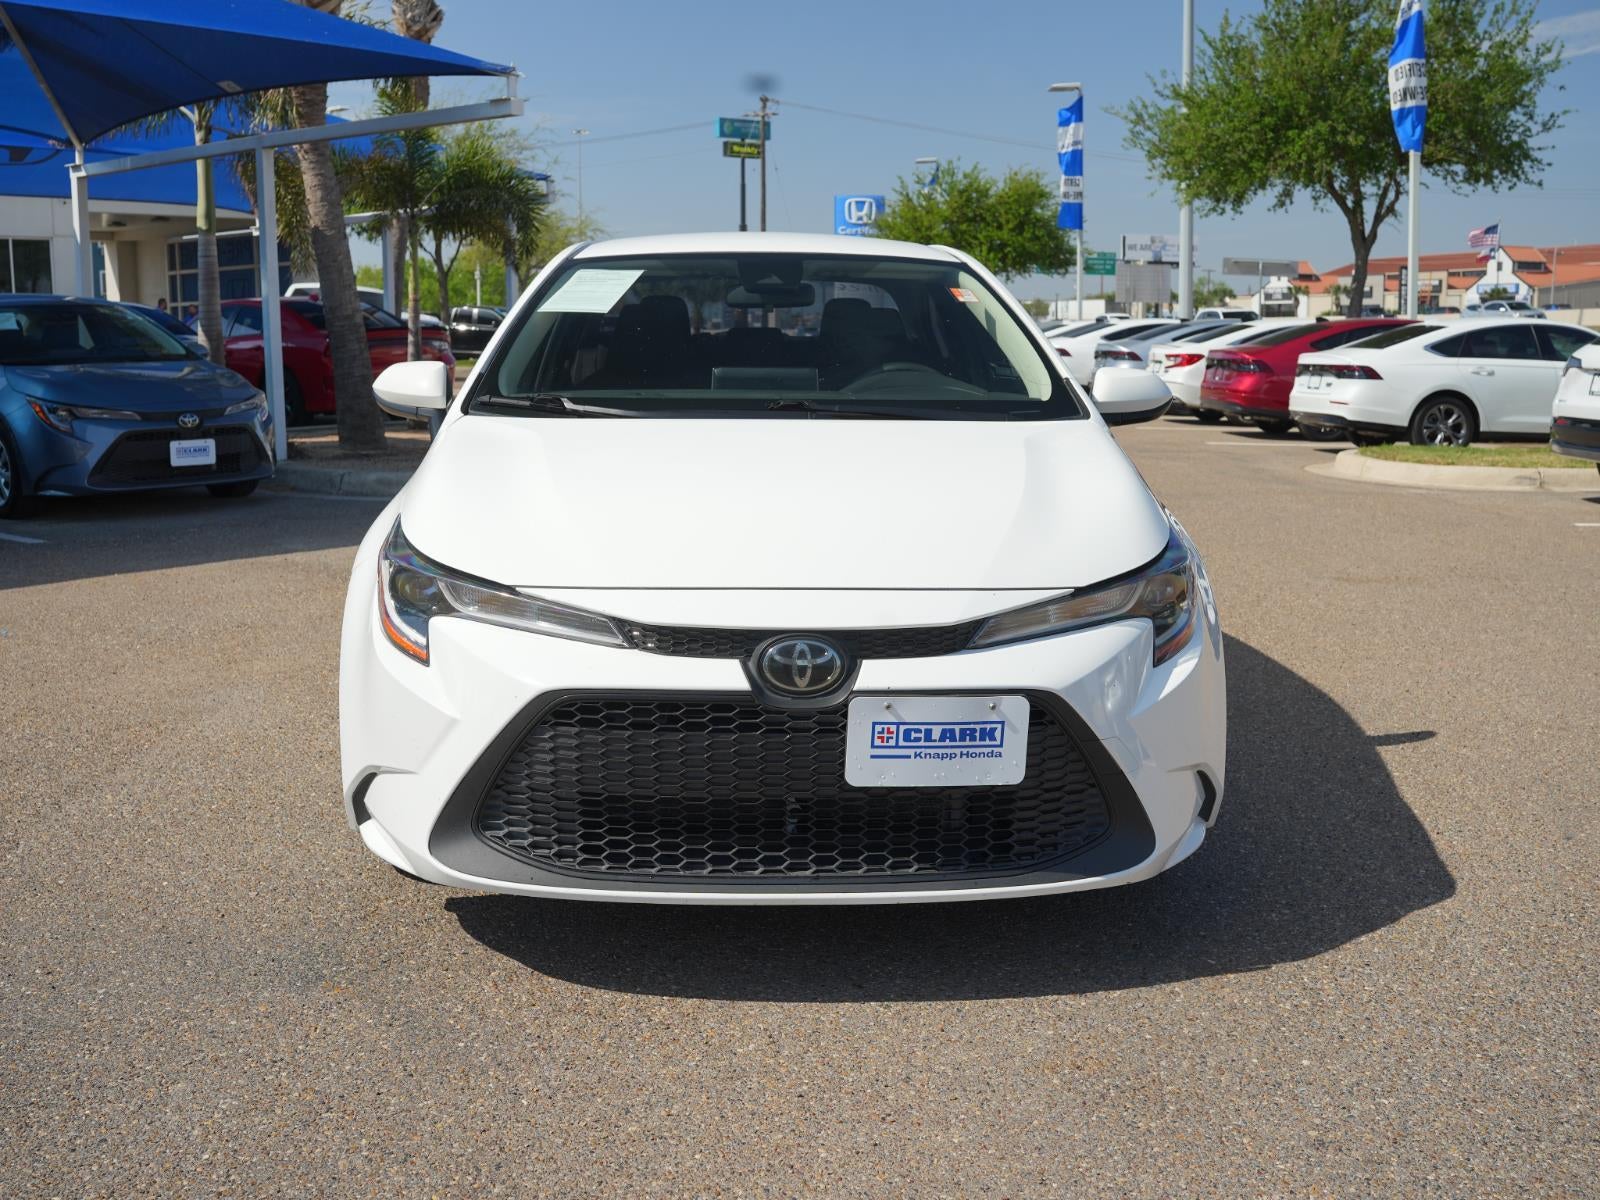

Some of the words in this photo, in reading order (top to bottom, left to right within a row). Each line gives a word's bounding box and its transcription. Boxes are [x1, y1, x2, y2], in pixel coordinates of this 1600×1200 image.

[902, 726, 999, 743] CLARK
[913, 751, 958, 761] Knapp
[959, 749, 1003, 759] Honda
